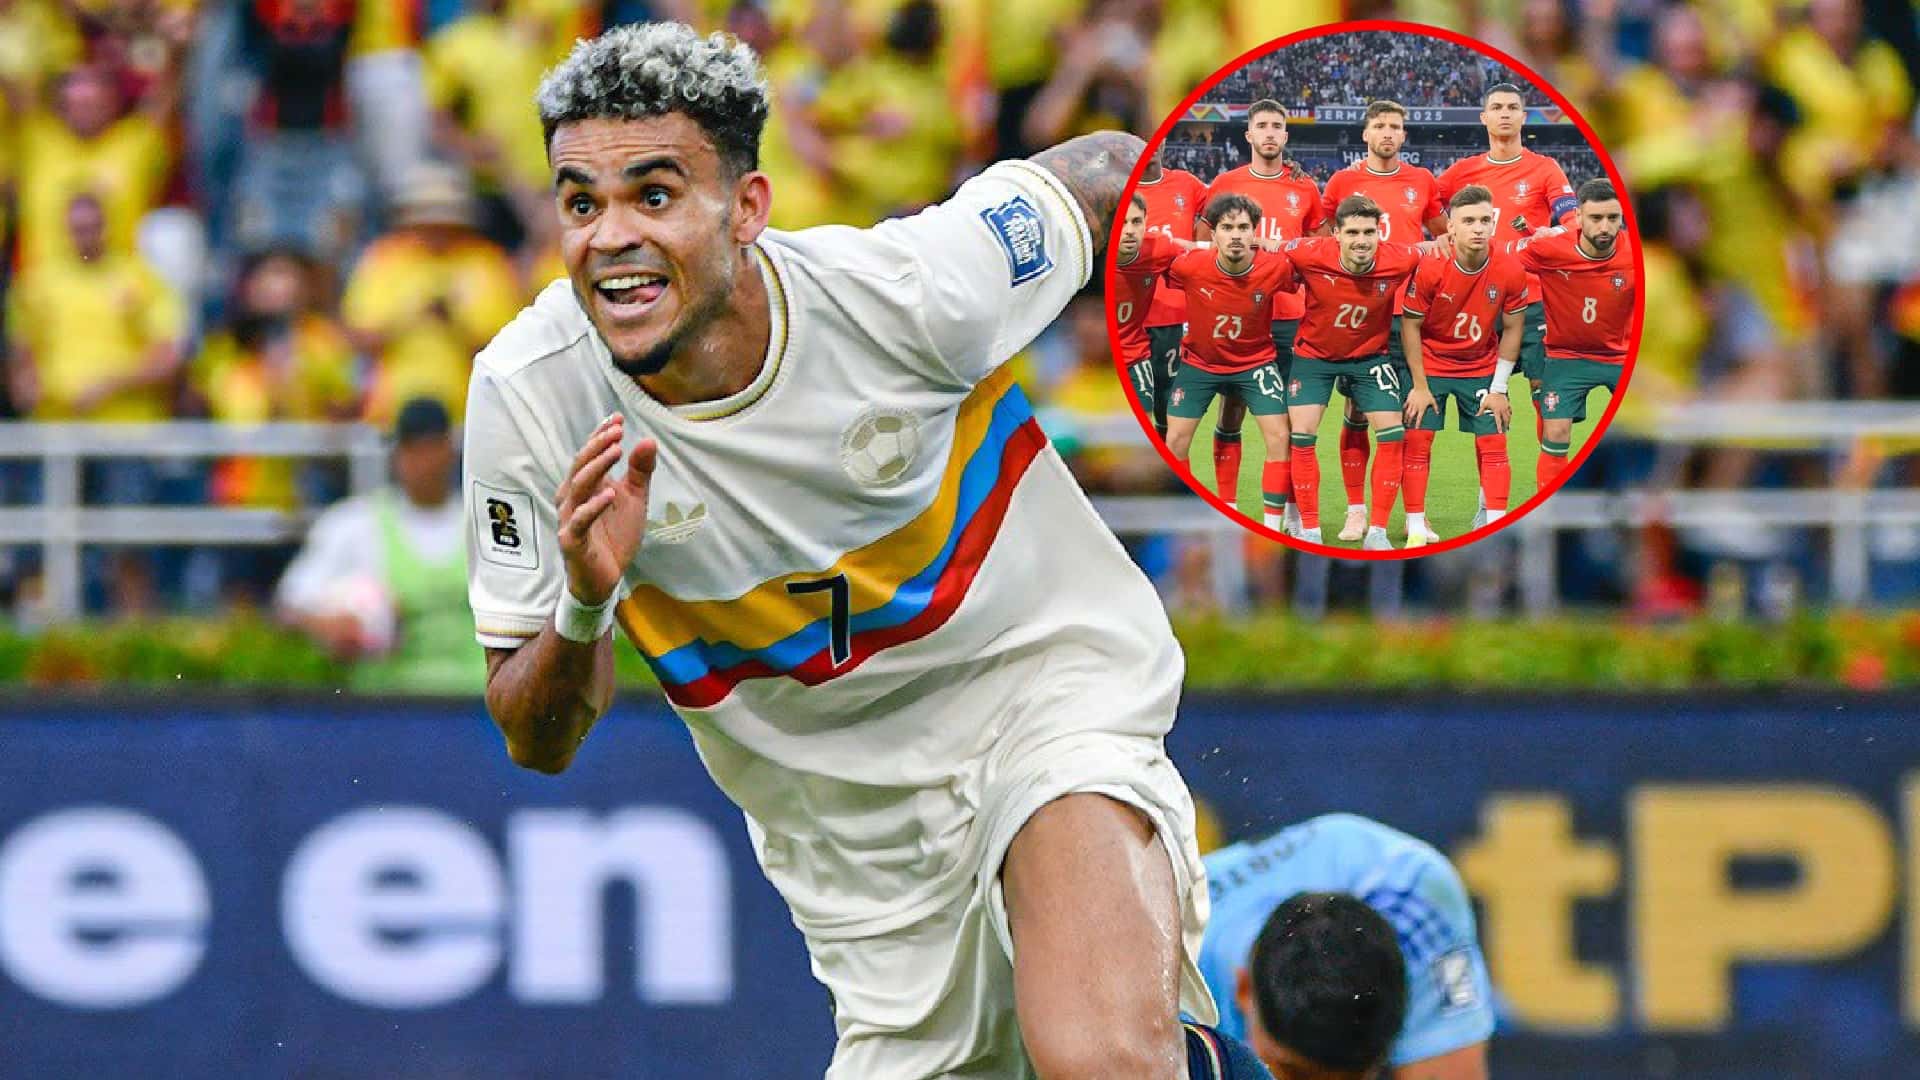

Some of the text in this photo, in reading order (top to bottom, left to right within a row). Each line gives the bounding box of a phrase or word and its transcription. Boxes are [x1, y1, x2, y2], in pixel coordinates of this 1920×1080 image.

[1260, 216, 1282, 240] 14
[1378, 213, 1391, 241] 3
[1334, 304, 1368, 329] 20
[1583, 297, 1597, 324] 8
[1213, 314, 1242, 340] 23
[1453, 312, 1482, 342] 26
[1165, 348, 1178, 378] 2
[1370, 363, 1400, 391] 20
[1252, 365, 1284, 395] 23
[785, 573, 851, 668] 7
[280, 806, 733, 1009] en
